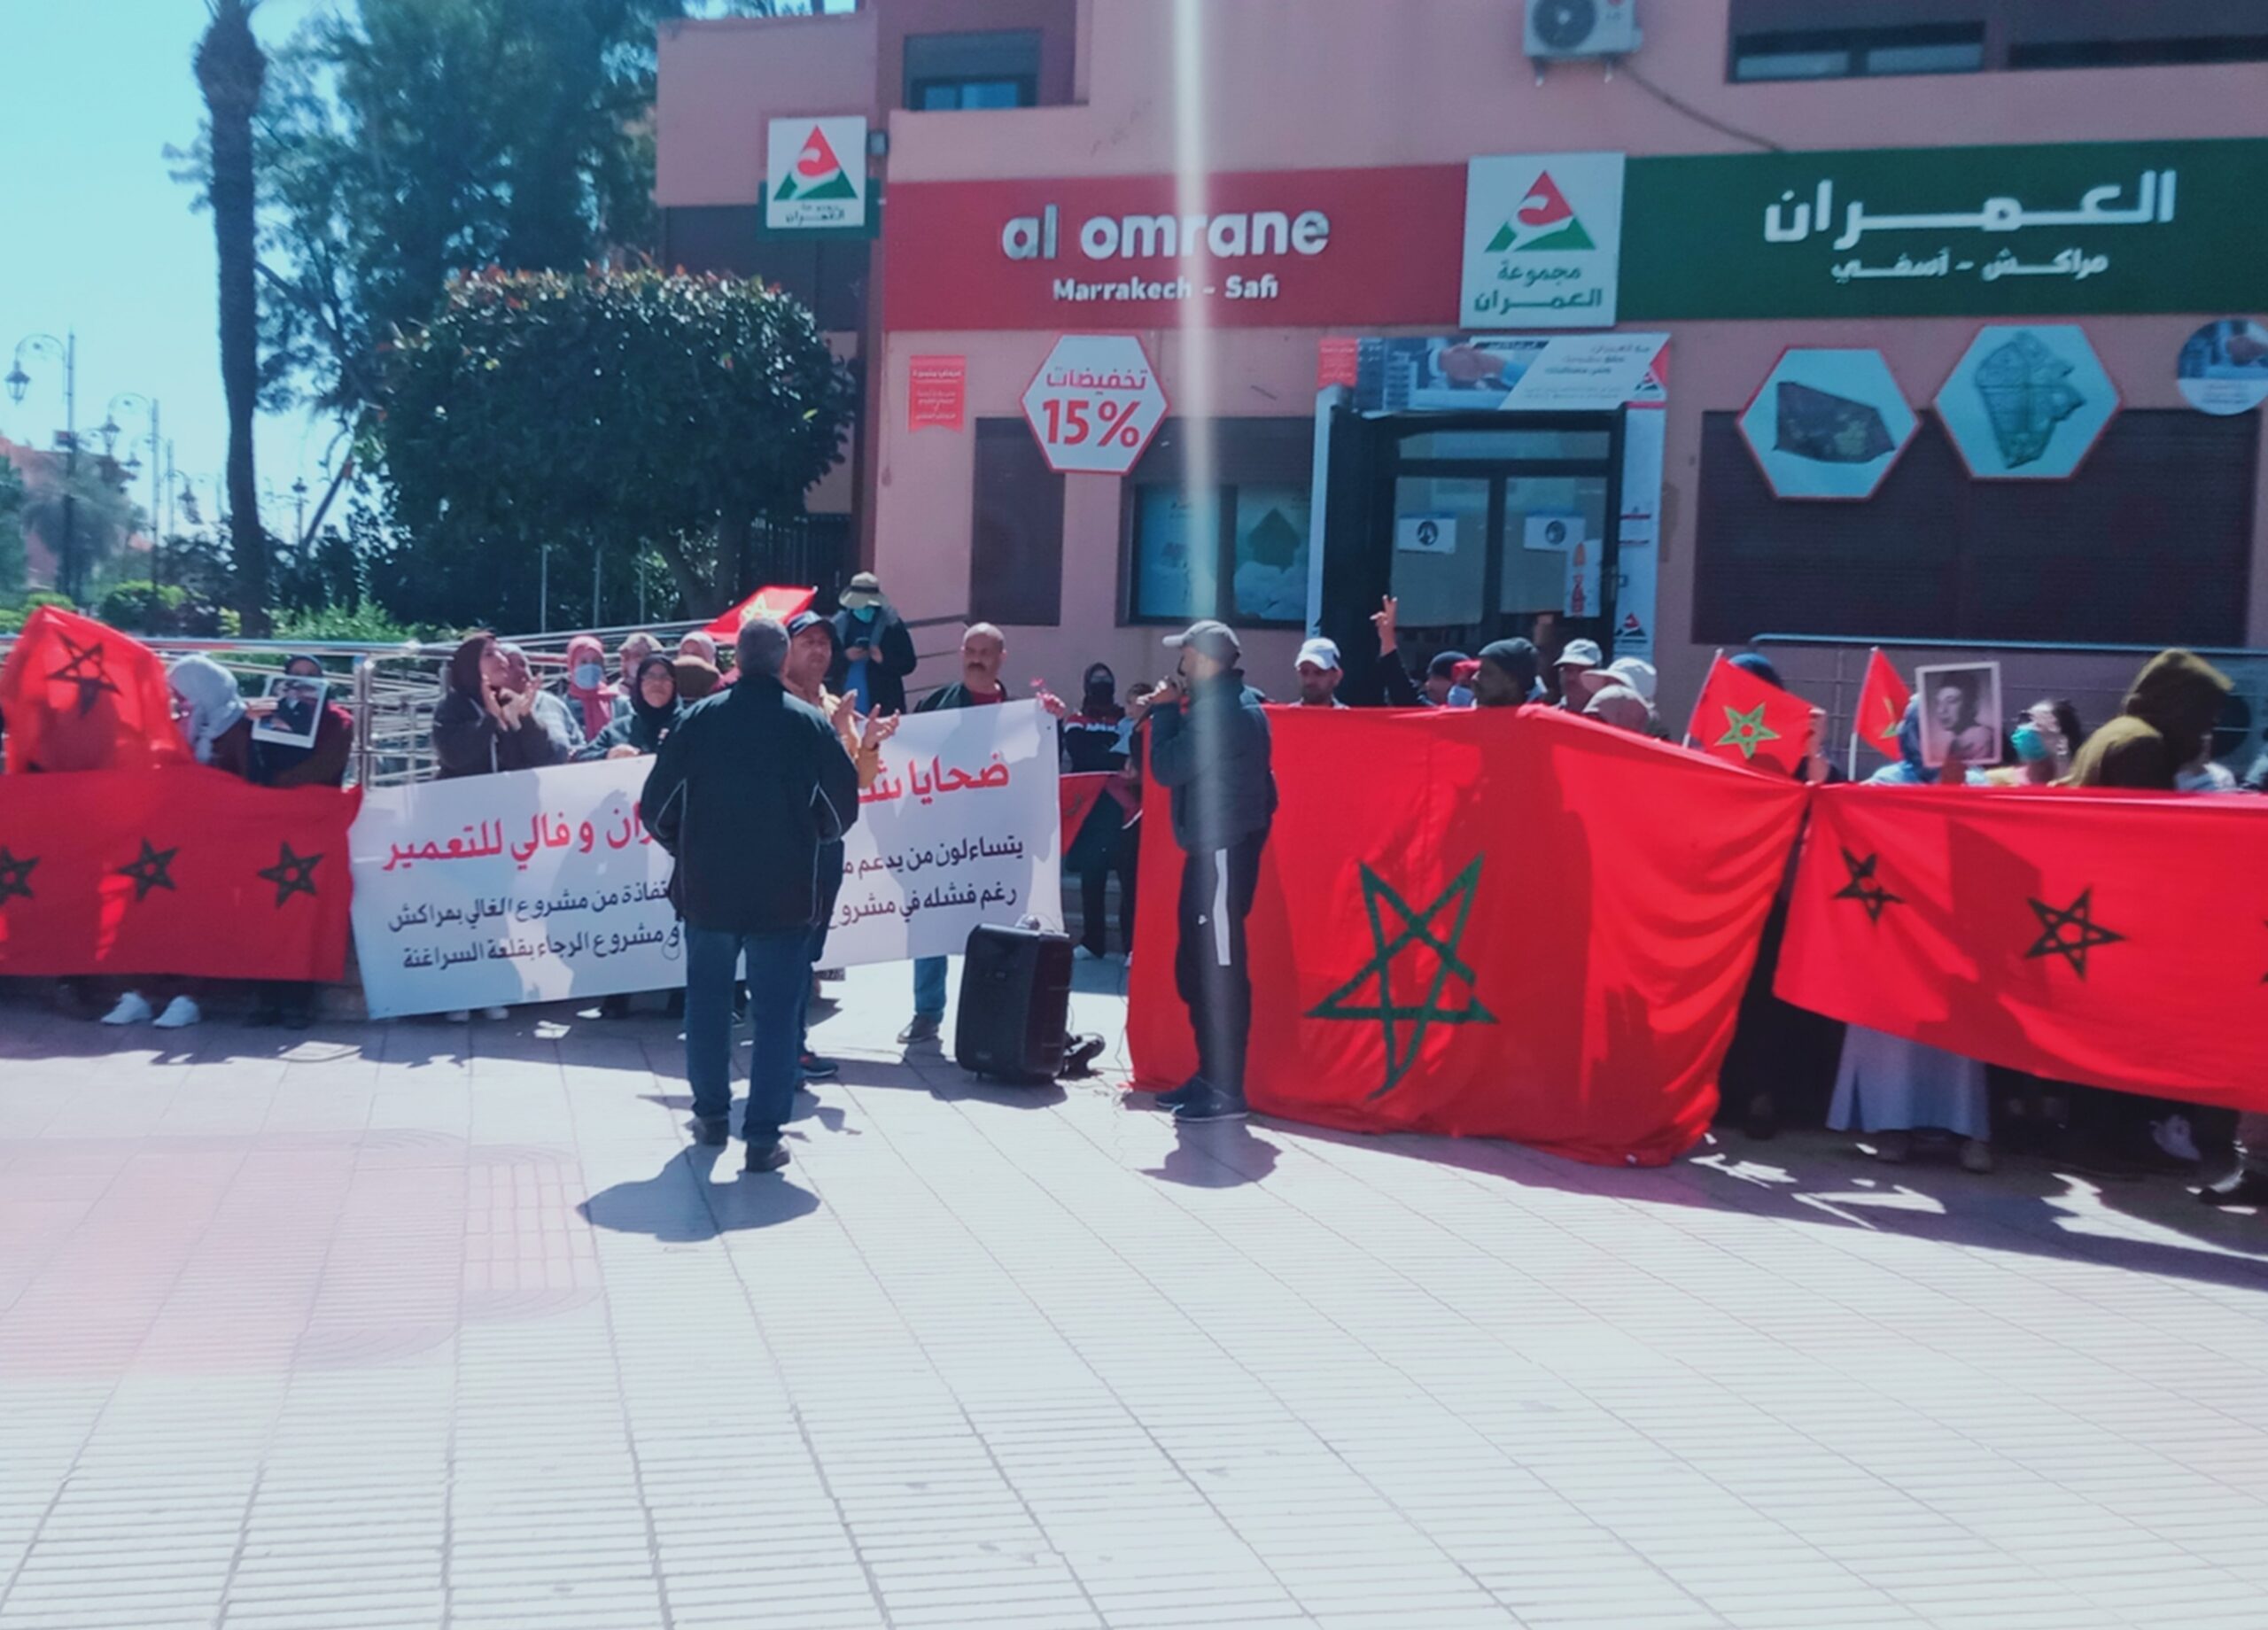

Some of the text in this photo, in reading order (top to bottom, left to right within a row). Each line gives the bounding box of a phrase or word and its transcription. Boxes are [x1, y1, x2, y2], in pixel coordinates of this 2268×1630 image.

[1765, 169, 2177, 251] العمران
[1002, 204, 1330, 260] al omrane
[1497, 259, 1581, 288] مجموعة
[1831, 247, 1949, 284] أسفي
[1981, 247, 2109, 282] مراكش
[1053, 276, 1192, 301] Marrakech
[1225, 274, 1278, 299] Safi
[1474, 288, 1603, 315] العمران
[1046, 366, 1148, 396] تخفيضات
[1043, 399, 1141, 448] 15%
[908, 752, 1009, 804] ضحايا
[382, 818, 502, 872] للتعمير
[511, 811, 571, 871] فالي
[936, 834, 1023, 867] يتساءلون
[858, 854, 904, 881] يدعم
[906, 847, 933, 872] من
[515, 889, 589, 922] مشروع
[591, 889, 618, 912] من
[829, 892, 896, 930] مشرو
[899, 889, 920, 923] في
[923, 881, 976, 909] فشله
[980, 881, 1017, 911] رغم
[388, 902, 462, 932] بمراكش
[465, 895, 512, 929] الغالي
[403, 940, 485, 971] السراغنة
[487, 938, 535, 961] بقلعة
[537, 931, 589, 959] الرجاء
[592, 922, 664, 959] مشروع
